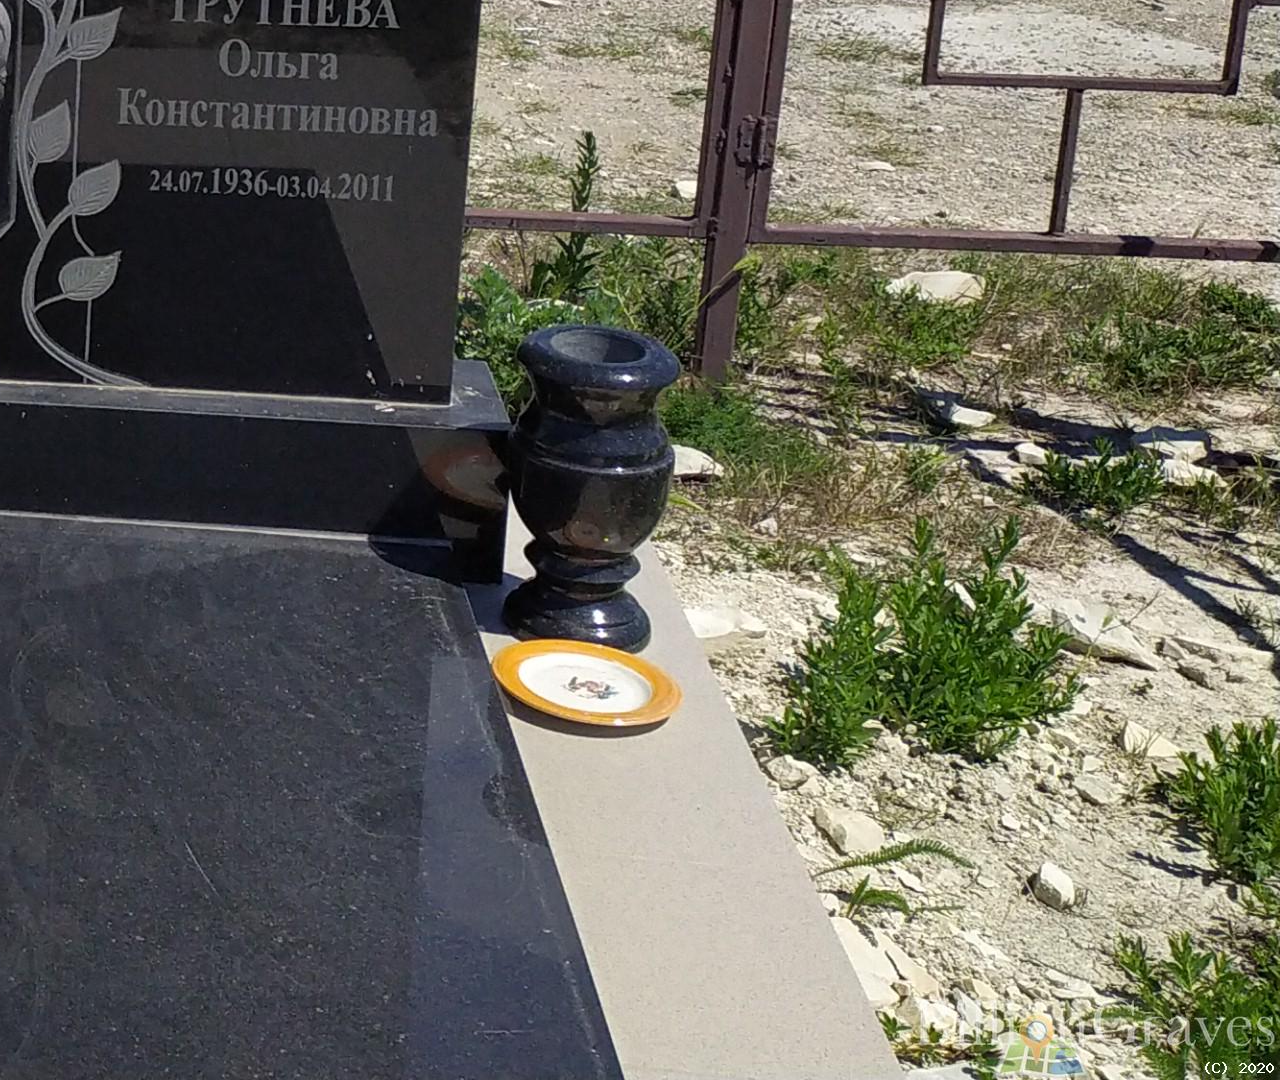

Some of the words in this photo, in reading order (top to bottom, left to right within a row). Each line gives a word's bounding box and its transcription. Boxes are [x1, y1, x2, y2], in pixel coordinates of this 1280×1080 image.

[218, 38, 339, 81] Ольга
[116, 87, 439, 138] Константиновна
[148, 168, 395, 203] 24.07.1936-03.04.2011
